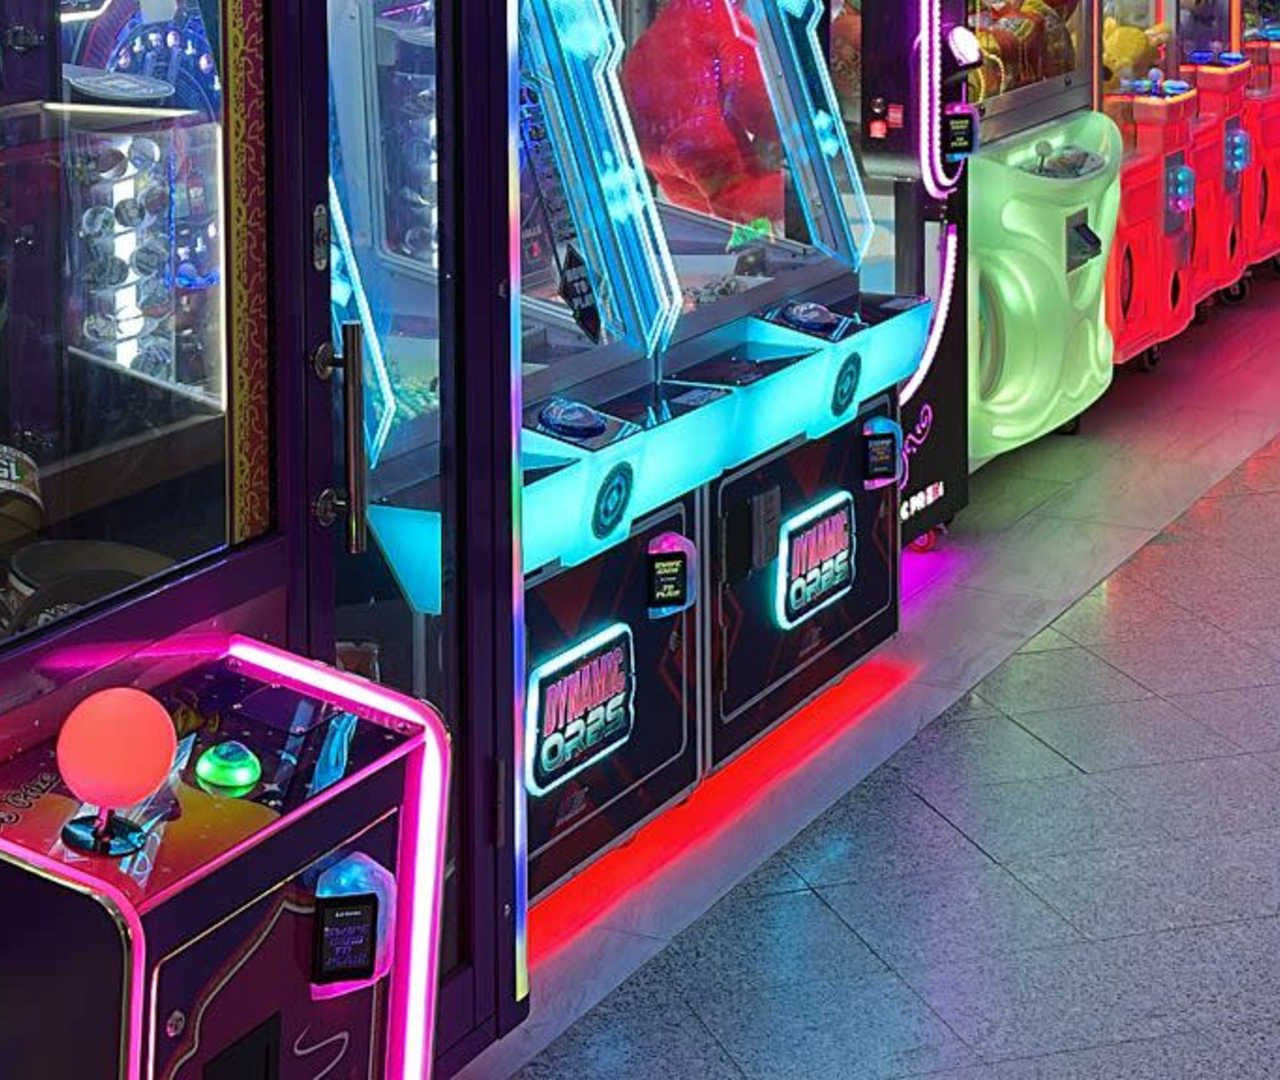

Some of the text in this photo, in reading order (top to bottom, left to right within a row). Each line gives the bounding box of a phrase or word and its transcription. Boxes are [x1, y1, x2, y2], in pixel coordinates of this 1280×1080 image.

[791, 509, 850, 581] DYNAMIC
[541, 691, 627, 772] ORBS
[543, 646, 627, 738] DYNAMIC
